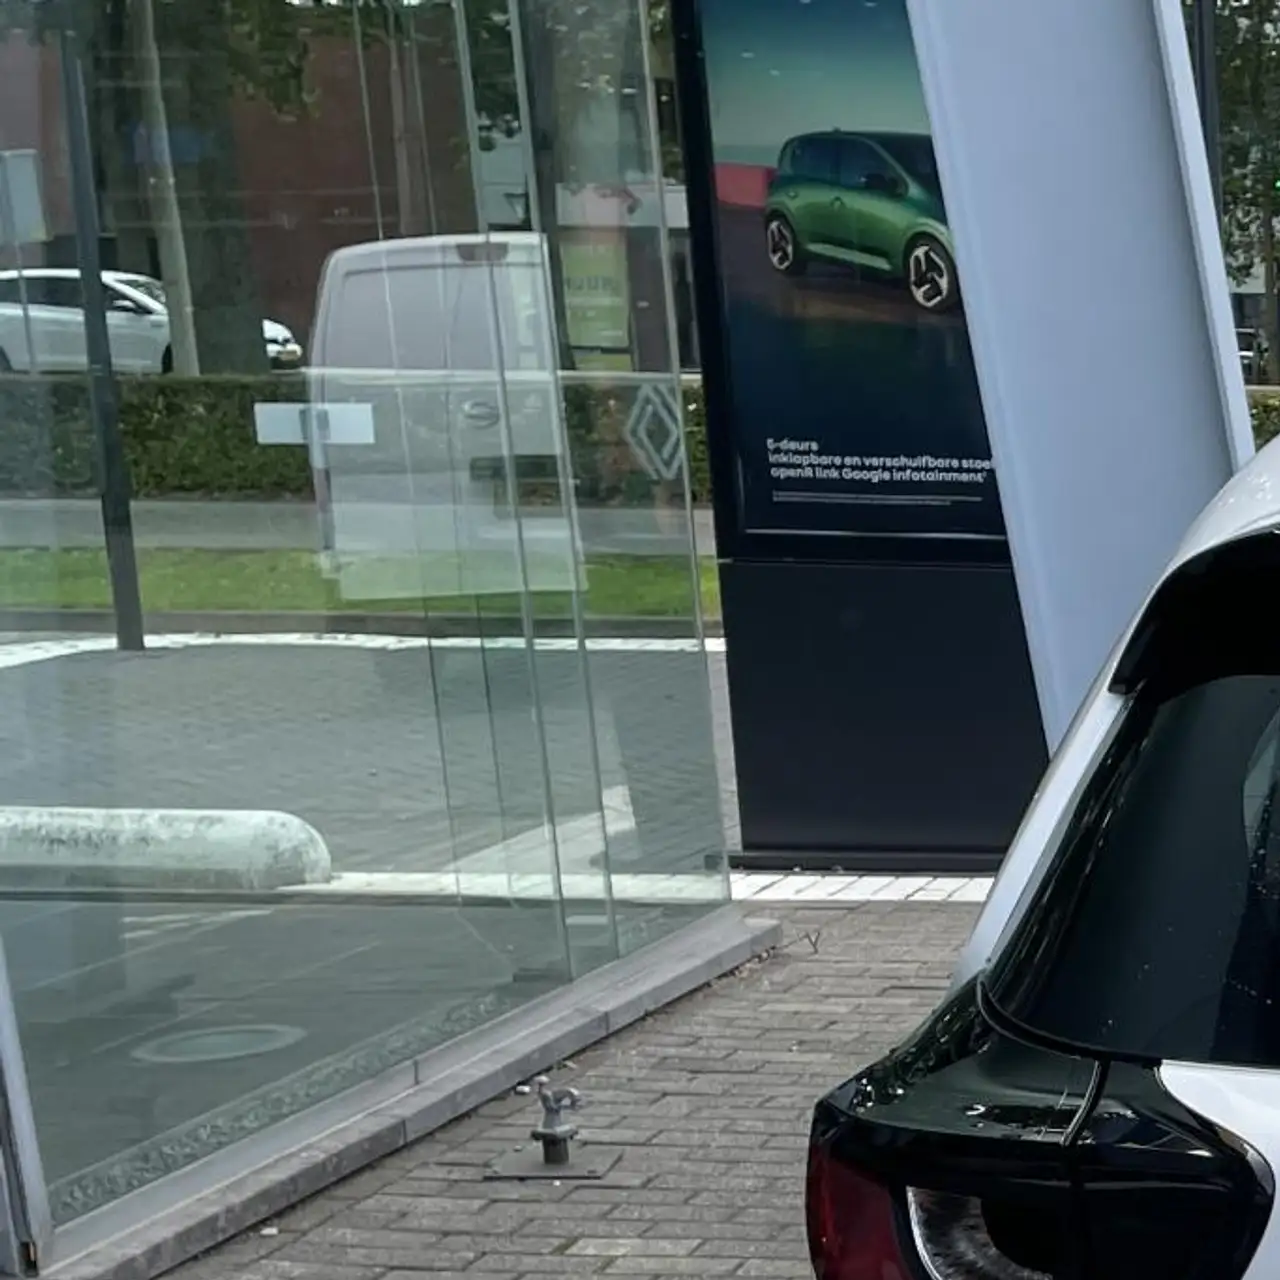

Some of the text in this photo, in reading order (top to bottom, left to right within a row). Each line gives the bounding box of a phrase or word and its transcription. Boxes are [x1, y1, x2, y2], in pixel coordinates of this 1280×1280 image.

[843, 456, 861, 466] en
[815, 467, 840, 478] link
[841, 468, 891, 483] Google
